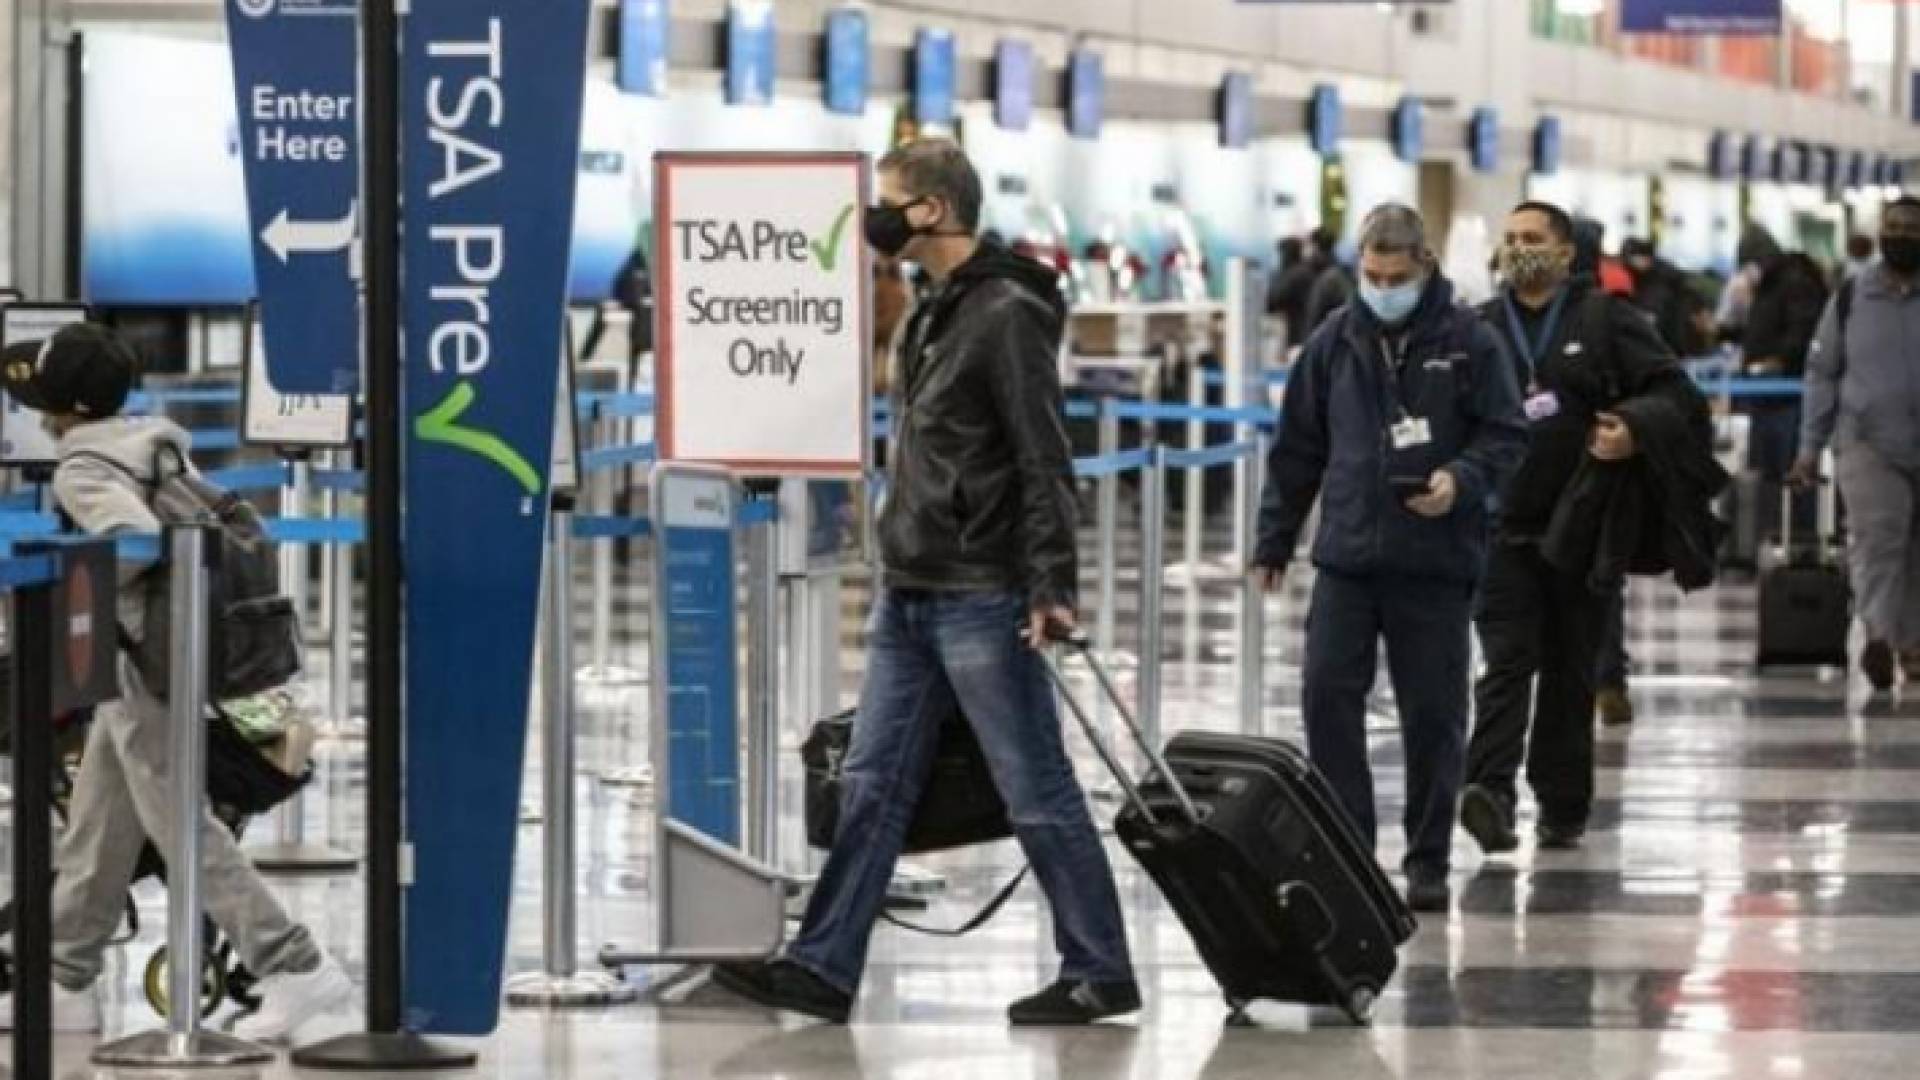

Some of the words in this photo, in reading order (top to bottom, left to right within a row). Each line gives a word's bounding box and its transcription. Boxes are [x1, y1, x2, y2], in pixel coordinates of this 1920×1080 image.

[252, 84, 352, 120] Enter
[427, 17, 503, 197] TSA
[256, 126, 347, 160] Here
[674, 219, 749, 262] TSA
[752, 219, 808, 262] Pre
[428, 225, 503, 374] Pre
[687, 287, 844, 335] Screening
[728, 337, 805, 385] Only
